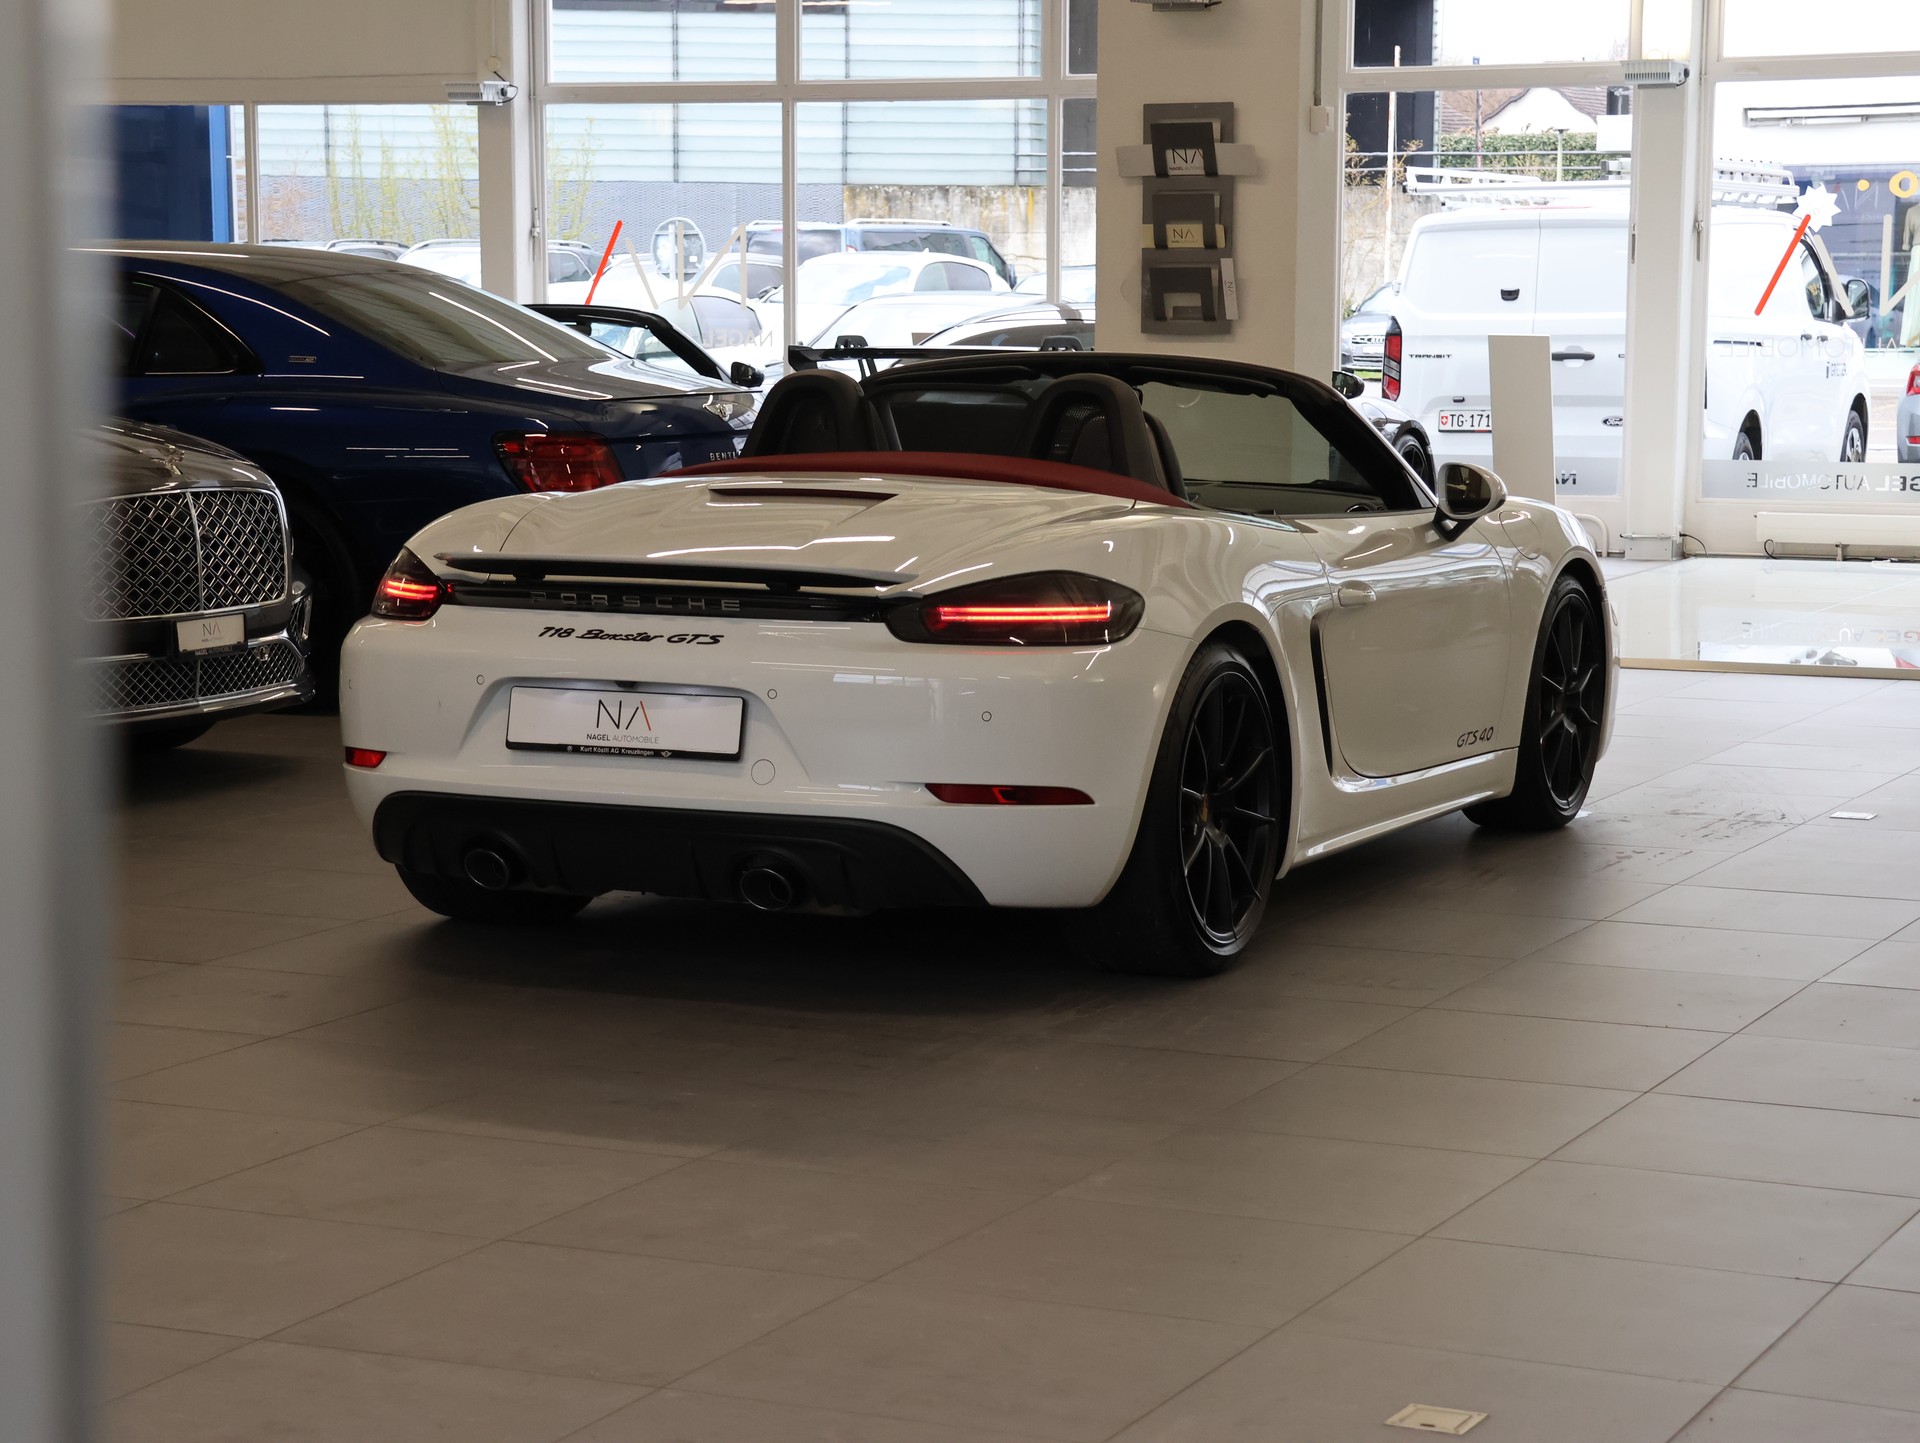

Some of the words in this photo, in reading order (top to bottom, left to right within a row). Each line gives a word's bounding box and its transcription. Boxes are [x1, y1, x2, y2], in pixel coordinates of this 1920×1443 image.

[530, 591, 741, 612] PORSCHE
[538, 626, 576, 638] 718
[575, 628, 664, 642] Boxster
[666, 633, 725, 645] GTS
[596, 699, 652, 731] NA
[586, 733, 611, 742] NAGEL
[612, 735, 660, 744] AUTOMOBILE
[1456, 730, 1479, 748] GTS
[621, 749, 655, 757] Kreuzlingen
